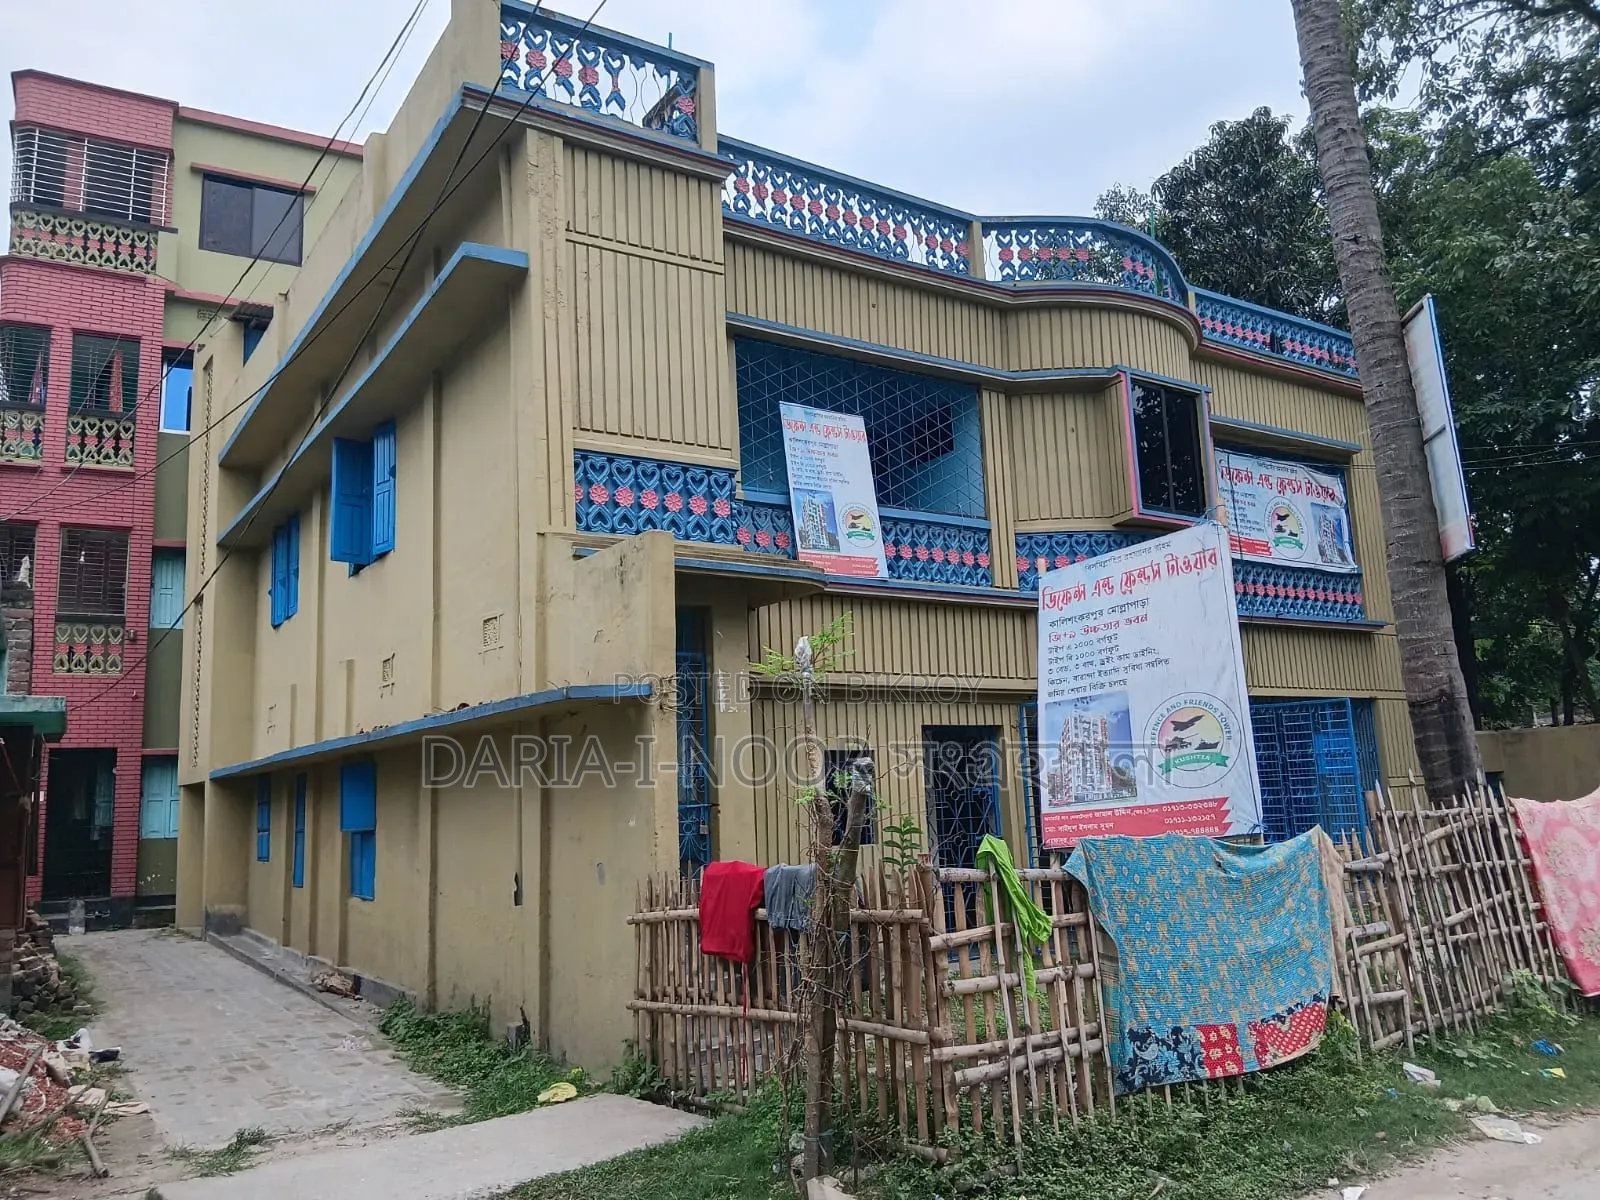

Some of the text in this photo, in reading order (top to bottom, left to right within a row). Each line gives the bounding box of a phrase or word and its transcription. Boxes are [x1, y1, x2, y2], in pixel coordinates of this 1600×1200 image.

[1042, 580, 1086, 611] ডিফেন্স
[1091, 575, 1115, 597] এন্ড
[1164, 547, 1217, 576] টাওয়ার
[1107, 597, 1151, 615] মোল্লাপাড়া
[1124, 613, 1148, 626] ভবন
[1150, 699, 1233, 746] DEFENCE AND FRIENDS TOWER
[1174, 754, 1210, 763] KUSHTIA
